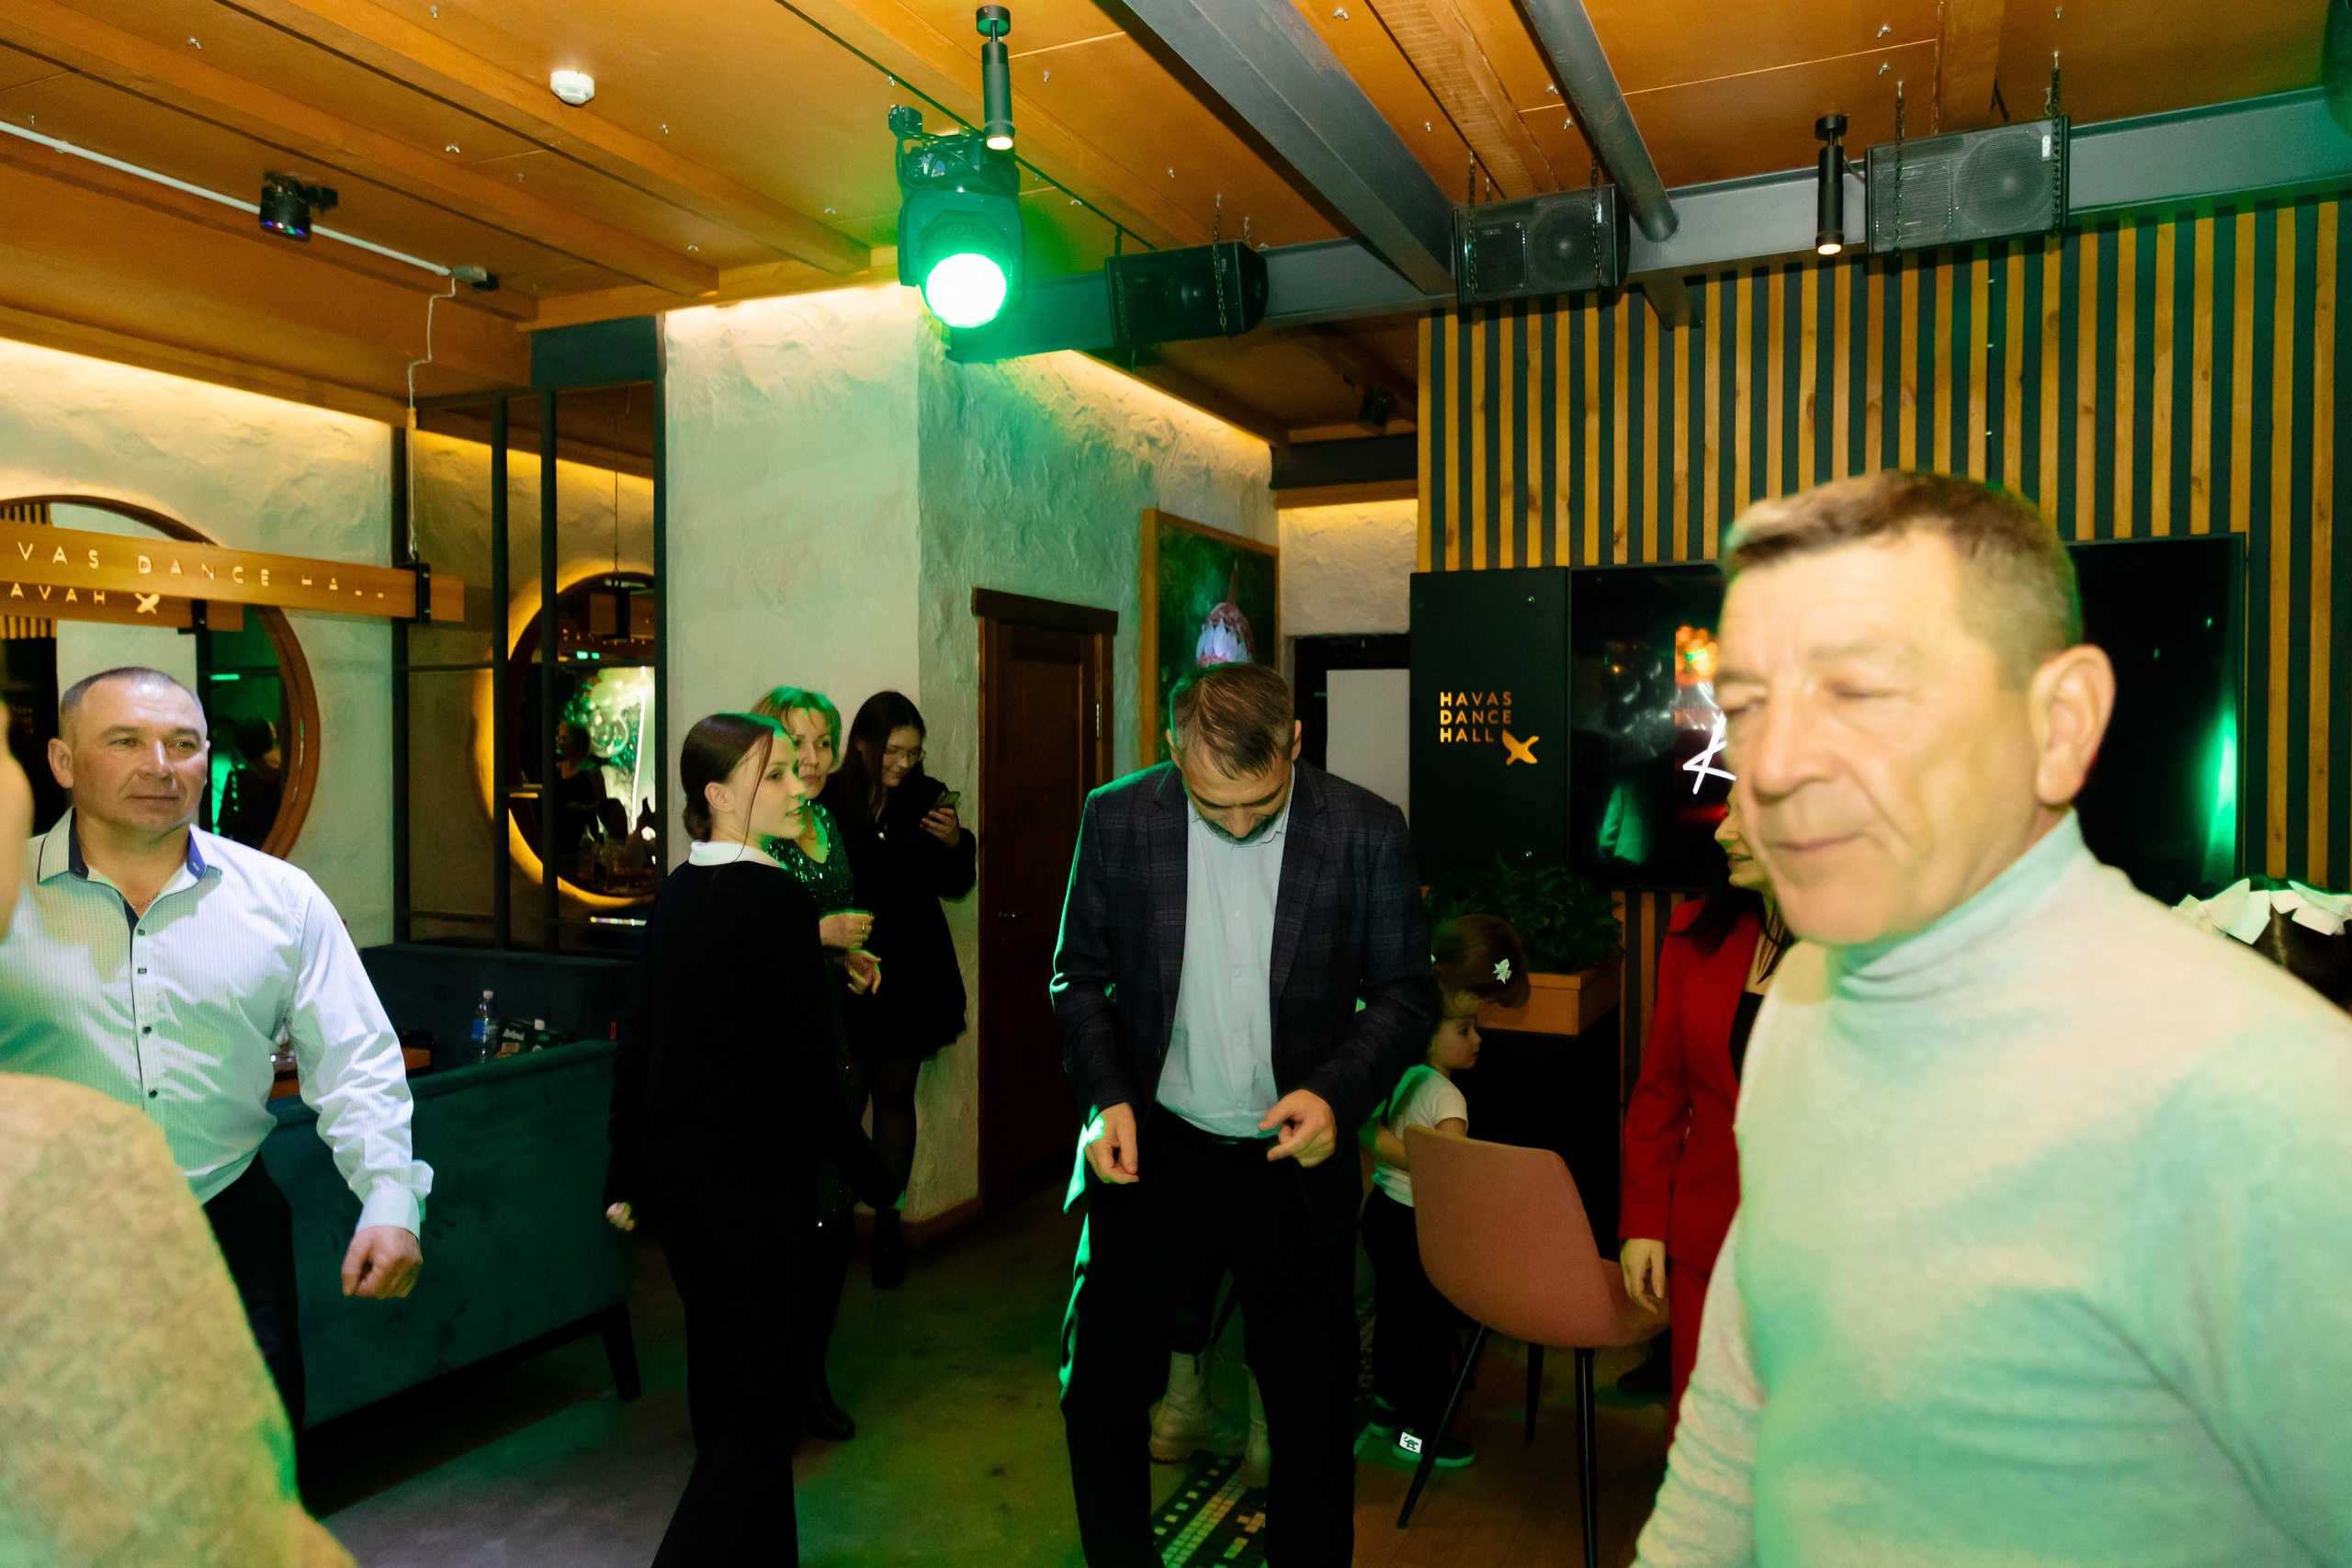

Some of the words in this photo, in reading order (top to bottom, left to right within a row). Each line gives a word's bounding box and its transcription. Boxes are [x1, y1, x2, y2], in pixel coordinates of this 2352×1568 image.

[17, 541, 100, 570] VAS
[138, 555, 270, 587] DANCE
[1440, 691, 1512, 707] HAVAS
[1440, 709, 1512, 726] DANCE
[1440, 727, 1495, 743] HALL
